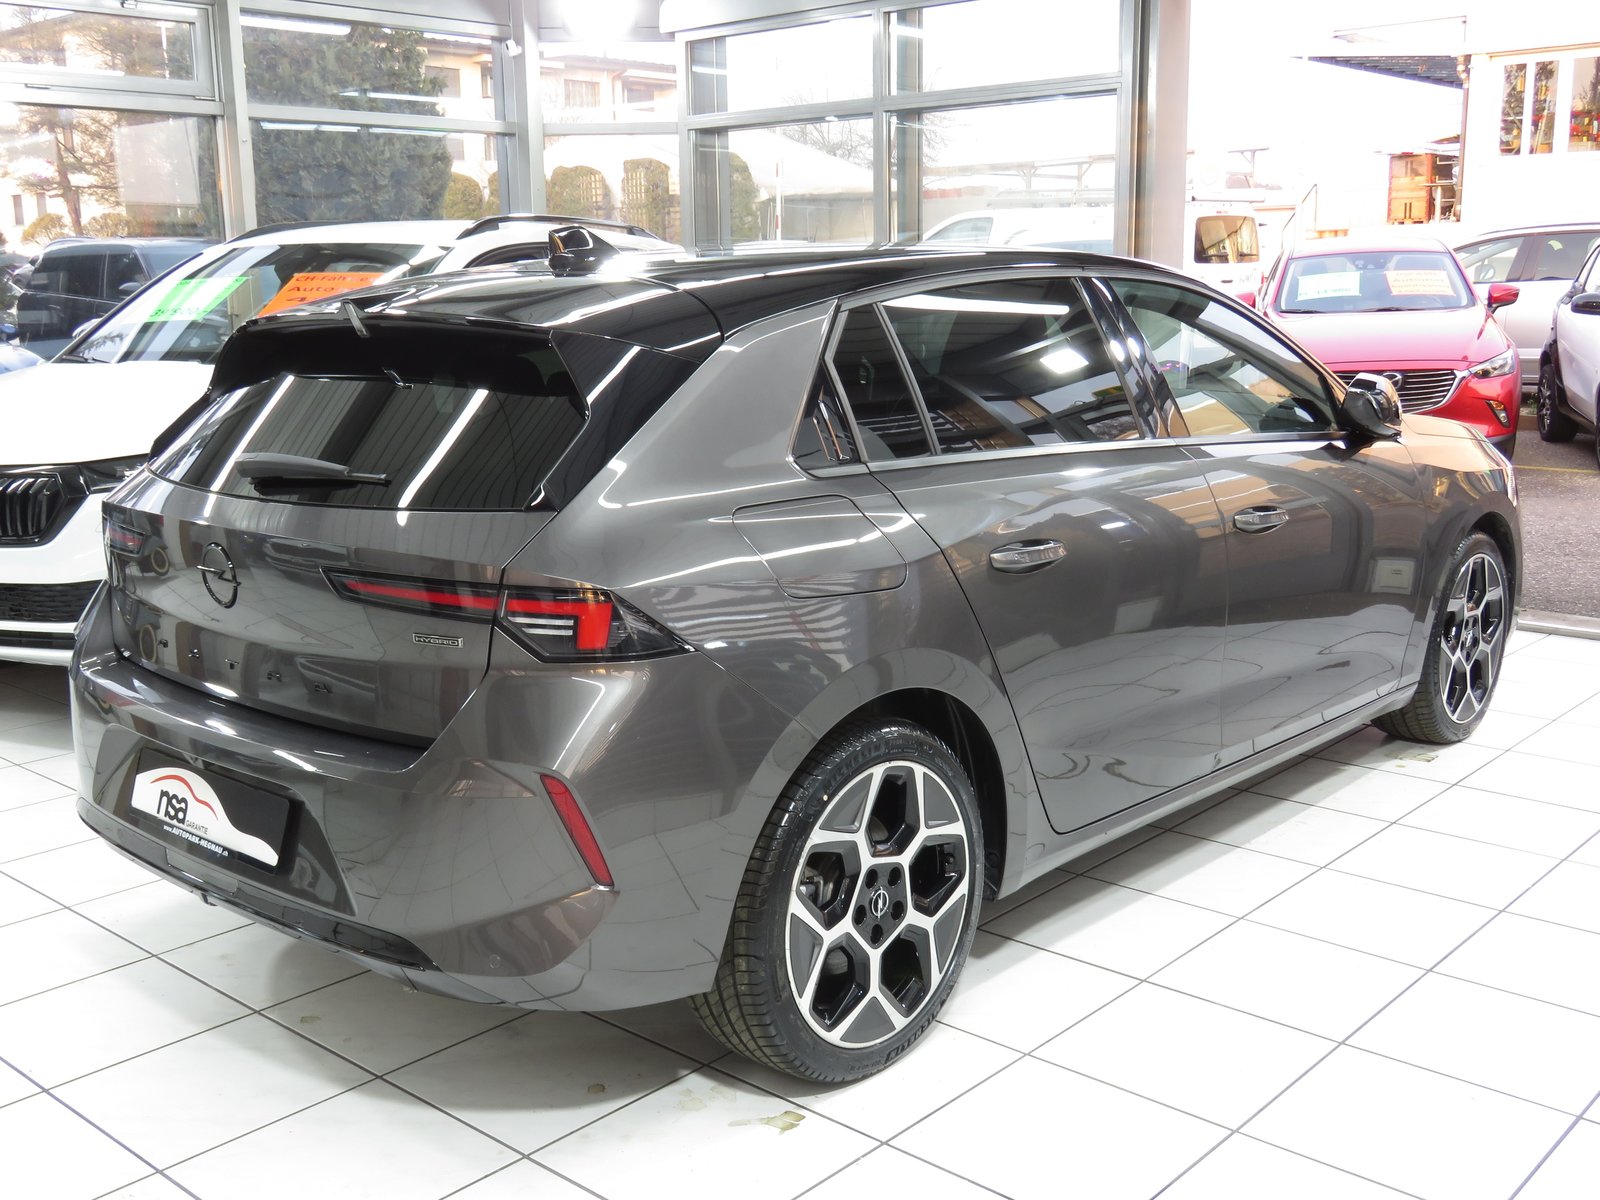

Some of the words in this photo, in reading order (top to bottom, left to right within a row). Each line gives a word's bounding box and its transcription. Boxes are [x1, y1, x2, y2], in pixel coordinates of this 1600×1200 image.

[415, 636, 458, 646] HYBRID
[157, 789, 188, 825] nsa
[185, 820, 208, 835] GARANTIE
[163, 824, 229, 857] www.AUTOPARK-HEGNAU.ch
